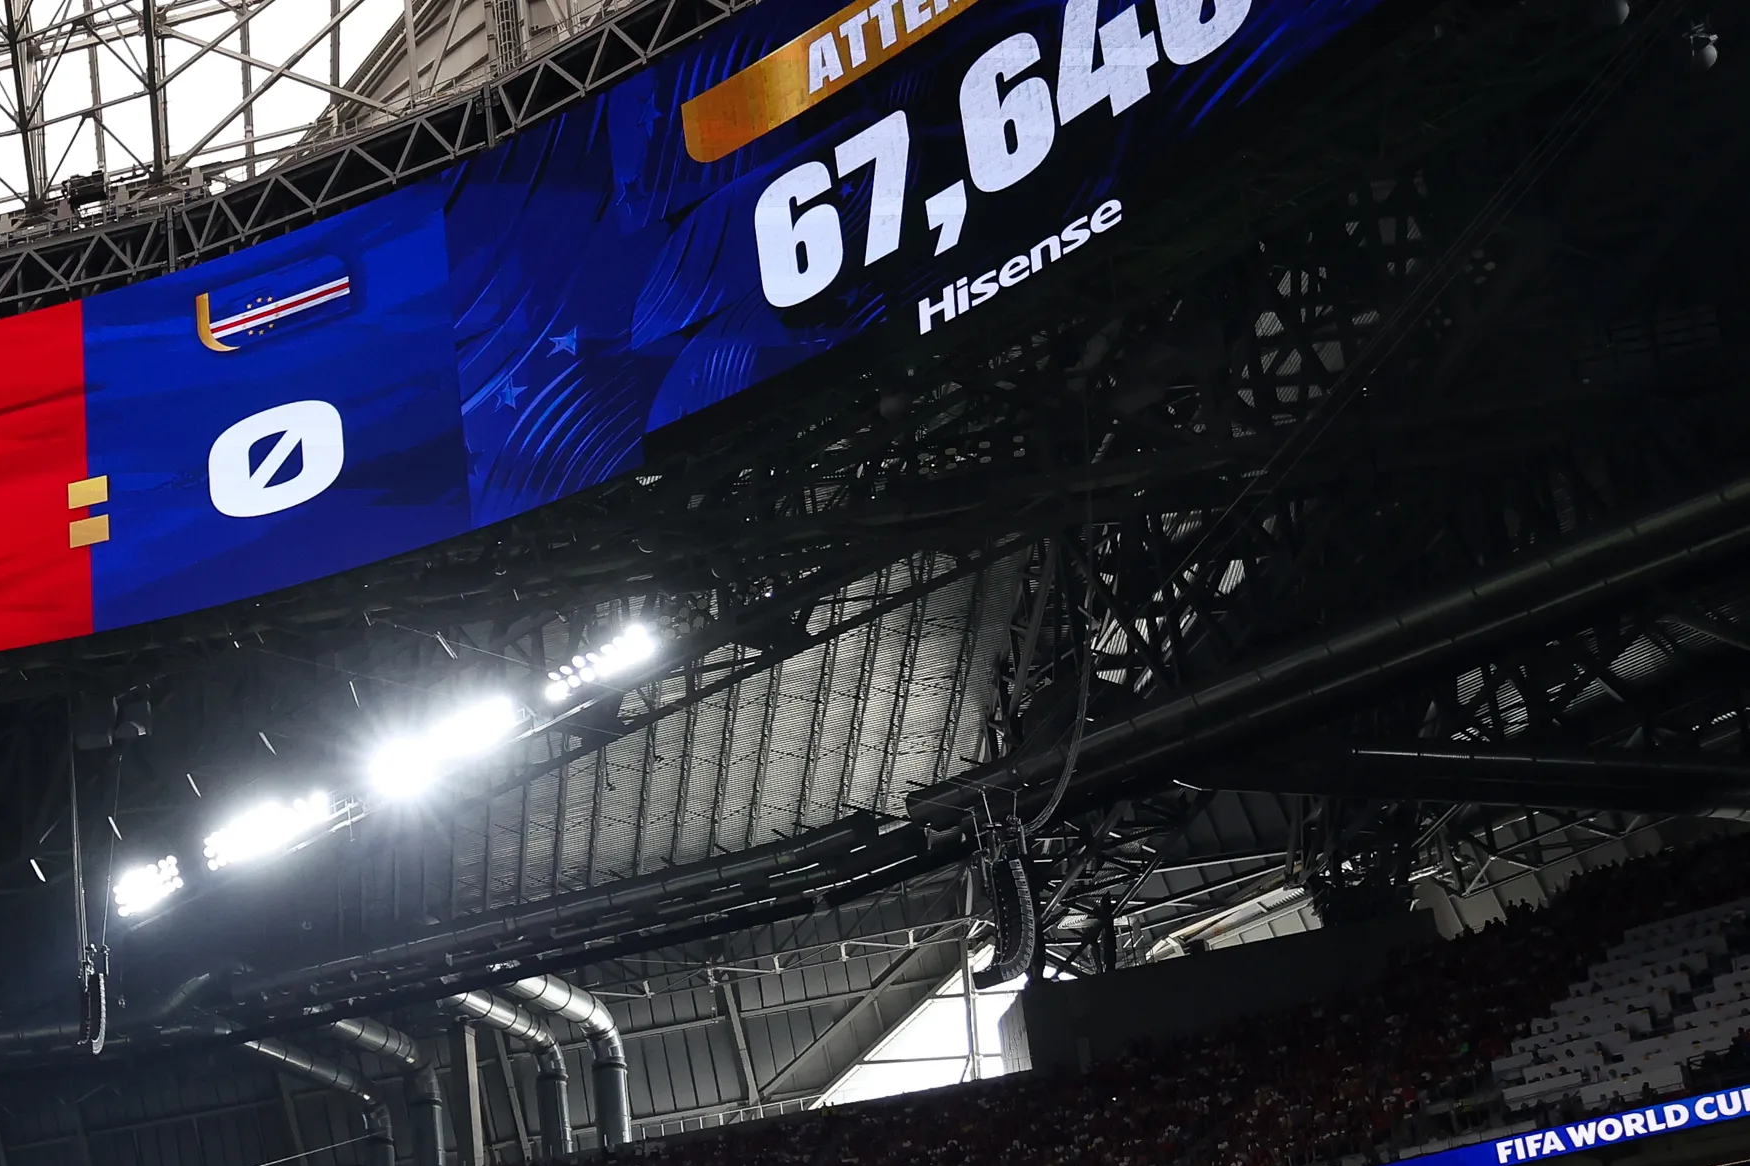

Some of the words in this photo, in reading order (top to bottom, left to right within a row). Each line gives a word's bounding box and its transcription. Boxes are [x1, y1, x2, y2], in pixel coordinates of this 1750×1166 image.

[919, 199, 1122, 336] Hisense
[208, 400, 344, 518] 0
[1496, 1131, 1566, 1164] FIFA
[1567, 1104, 1690, 1148] WORLD
